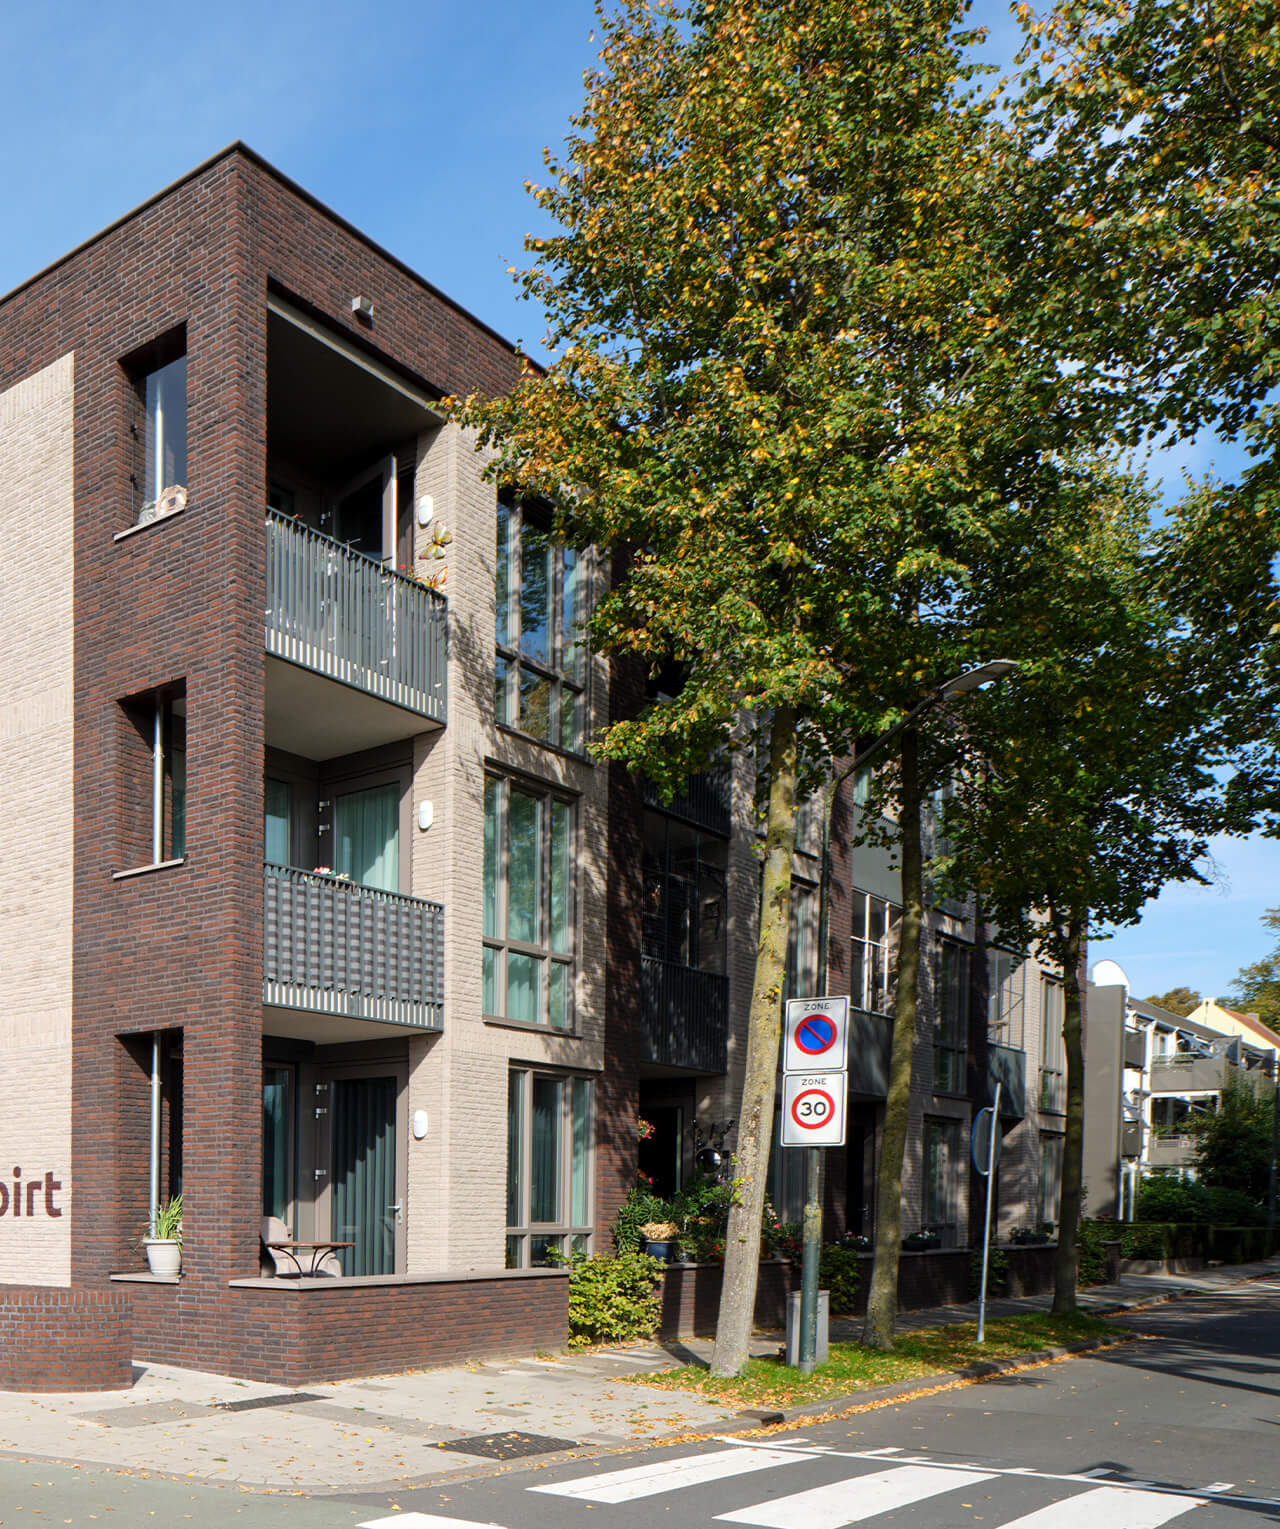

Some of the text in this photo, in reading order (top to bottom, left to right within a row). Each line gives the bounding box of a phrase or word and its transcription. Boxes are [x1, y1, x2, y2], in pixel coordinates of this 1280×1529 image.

[804, 1002, 831, 1011] ZONE
[801, 1077, 827, 1086] ZONE
[800, 1102, 826, 1116] 30
